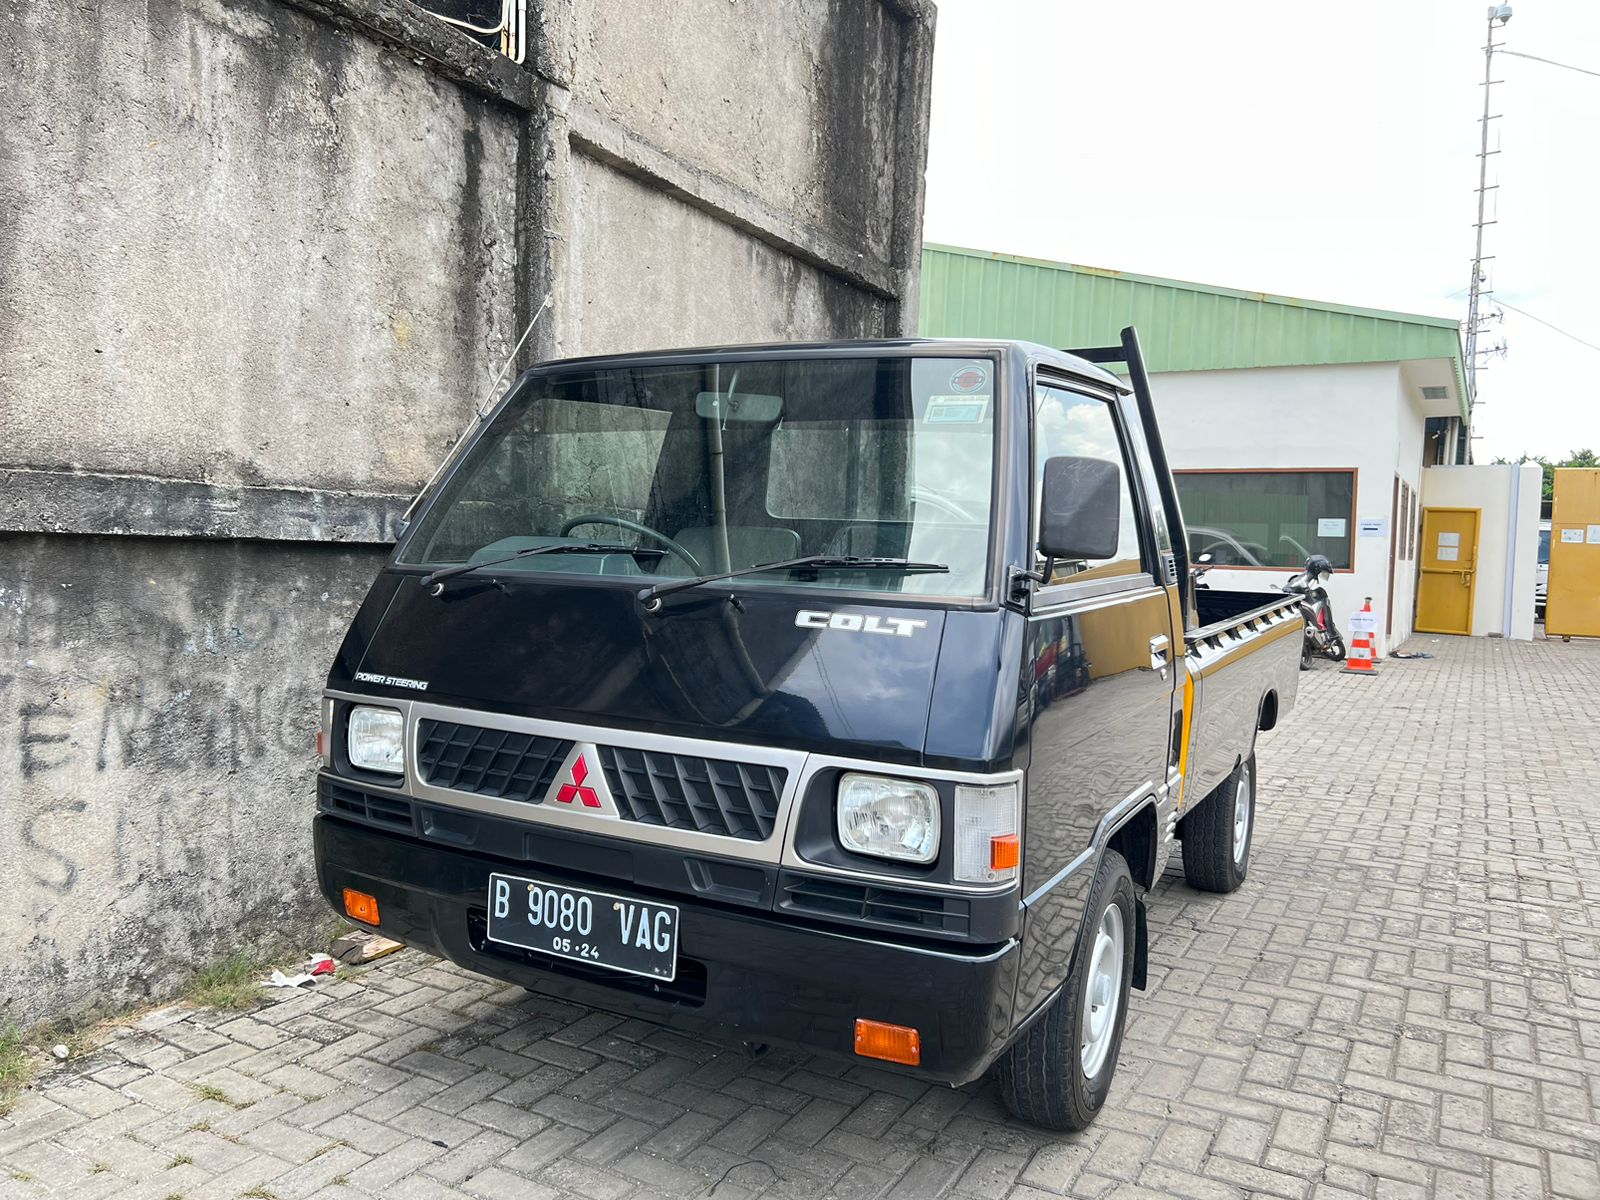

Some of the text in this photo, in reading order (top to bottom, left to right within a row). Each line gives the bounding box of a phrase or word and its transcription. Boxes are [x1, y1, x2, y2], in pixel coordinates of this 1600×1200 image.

[795, 609, 928, 637] COLT
[355, 672, 429, 691] POWER STEERING
[494, 879, 671, 953] B 9080 VAG
